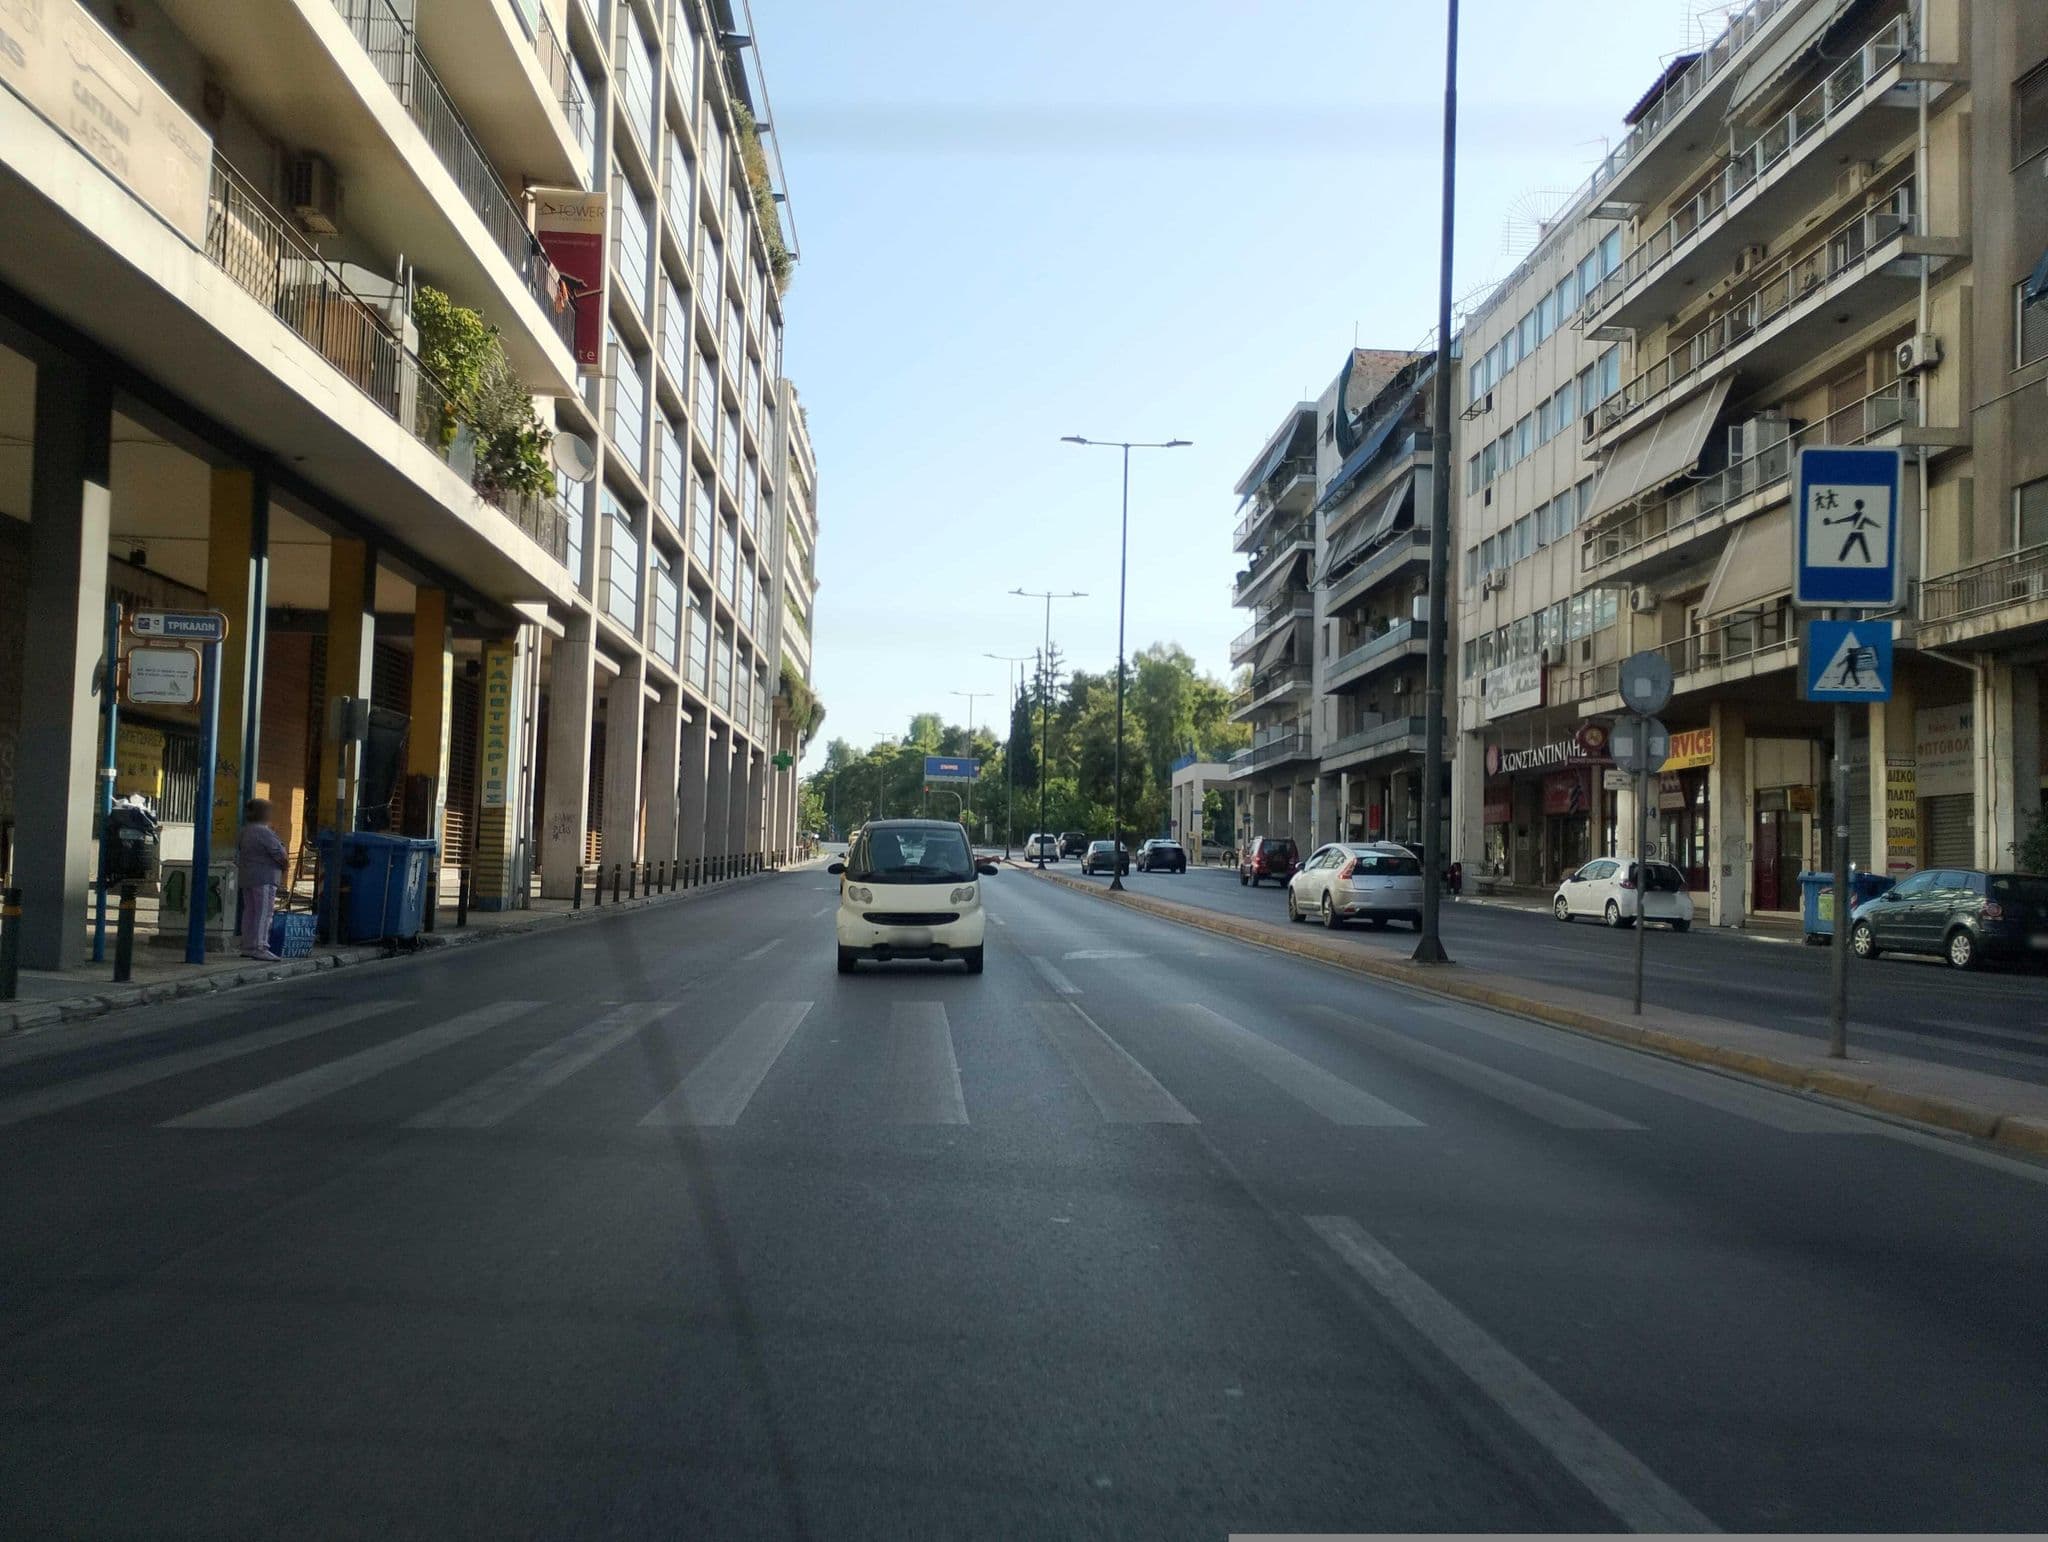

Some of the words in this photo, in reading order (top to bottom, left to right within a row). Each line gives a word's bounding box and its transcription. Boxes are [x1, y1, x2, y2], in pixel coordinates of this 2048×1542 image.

[558, 203, 606, 219] TOWER
[167, 620, 216, 632] ΤΡΙΚΑΛΩΝ
[1671, 729, 1712, 759] RVICE
[1887, 769, 1916, 782] ΔΙΣΚΟΙ
[1887, 808, 1916, 820] ΦΡΕΝΑ
